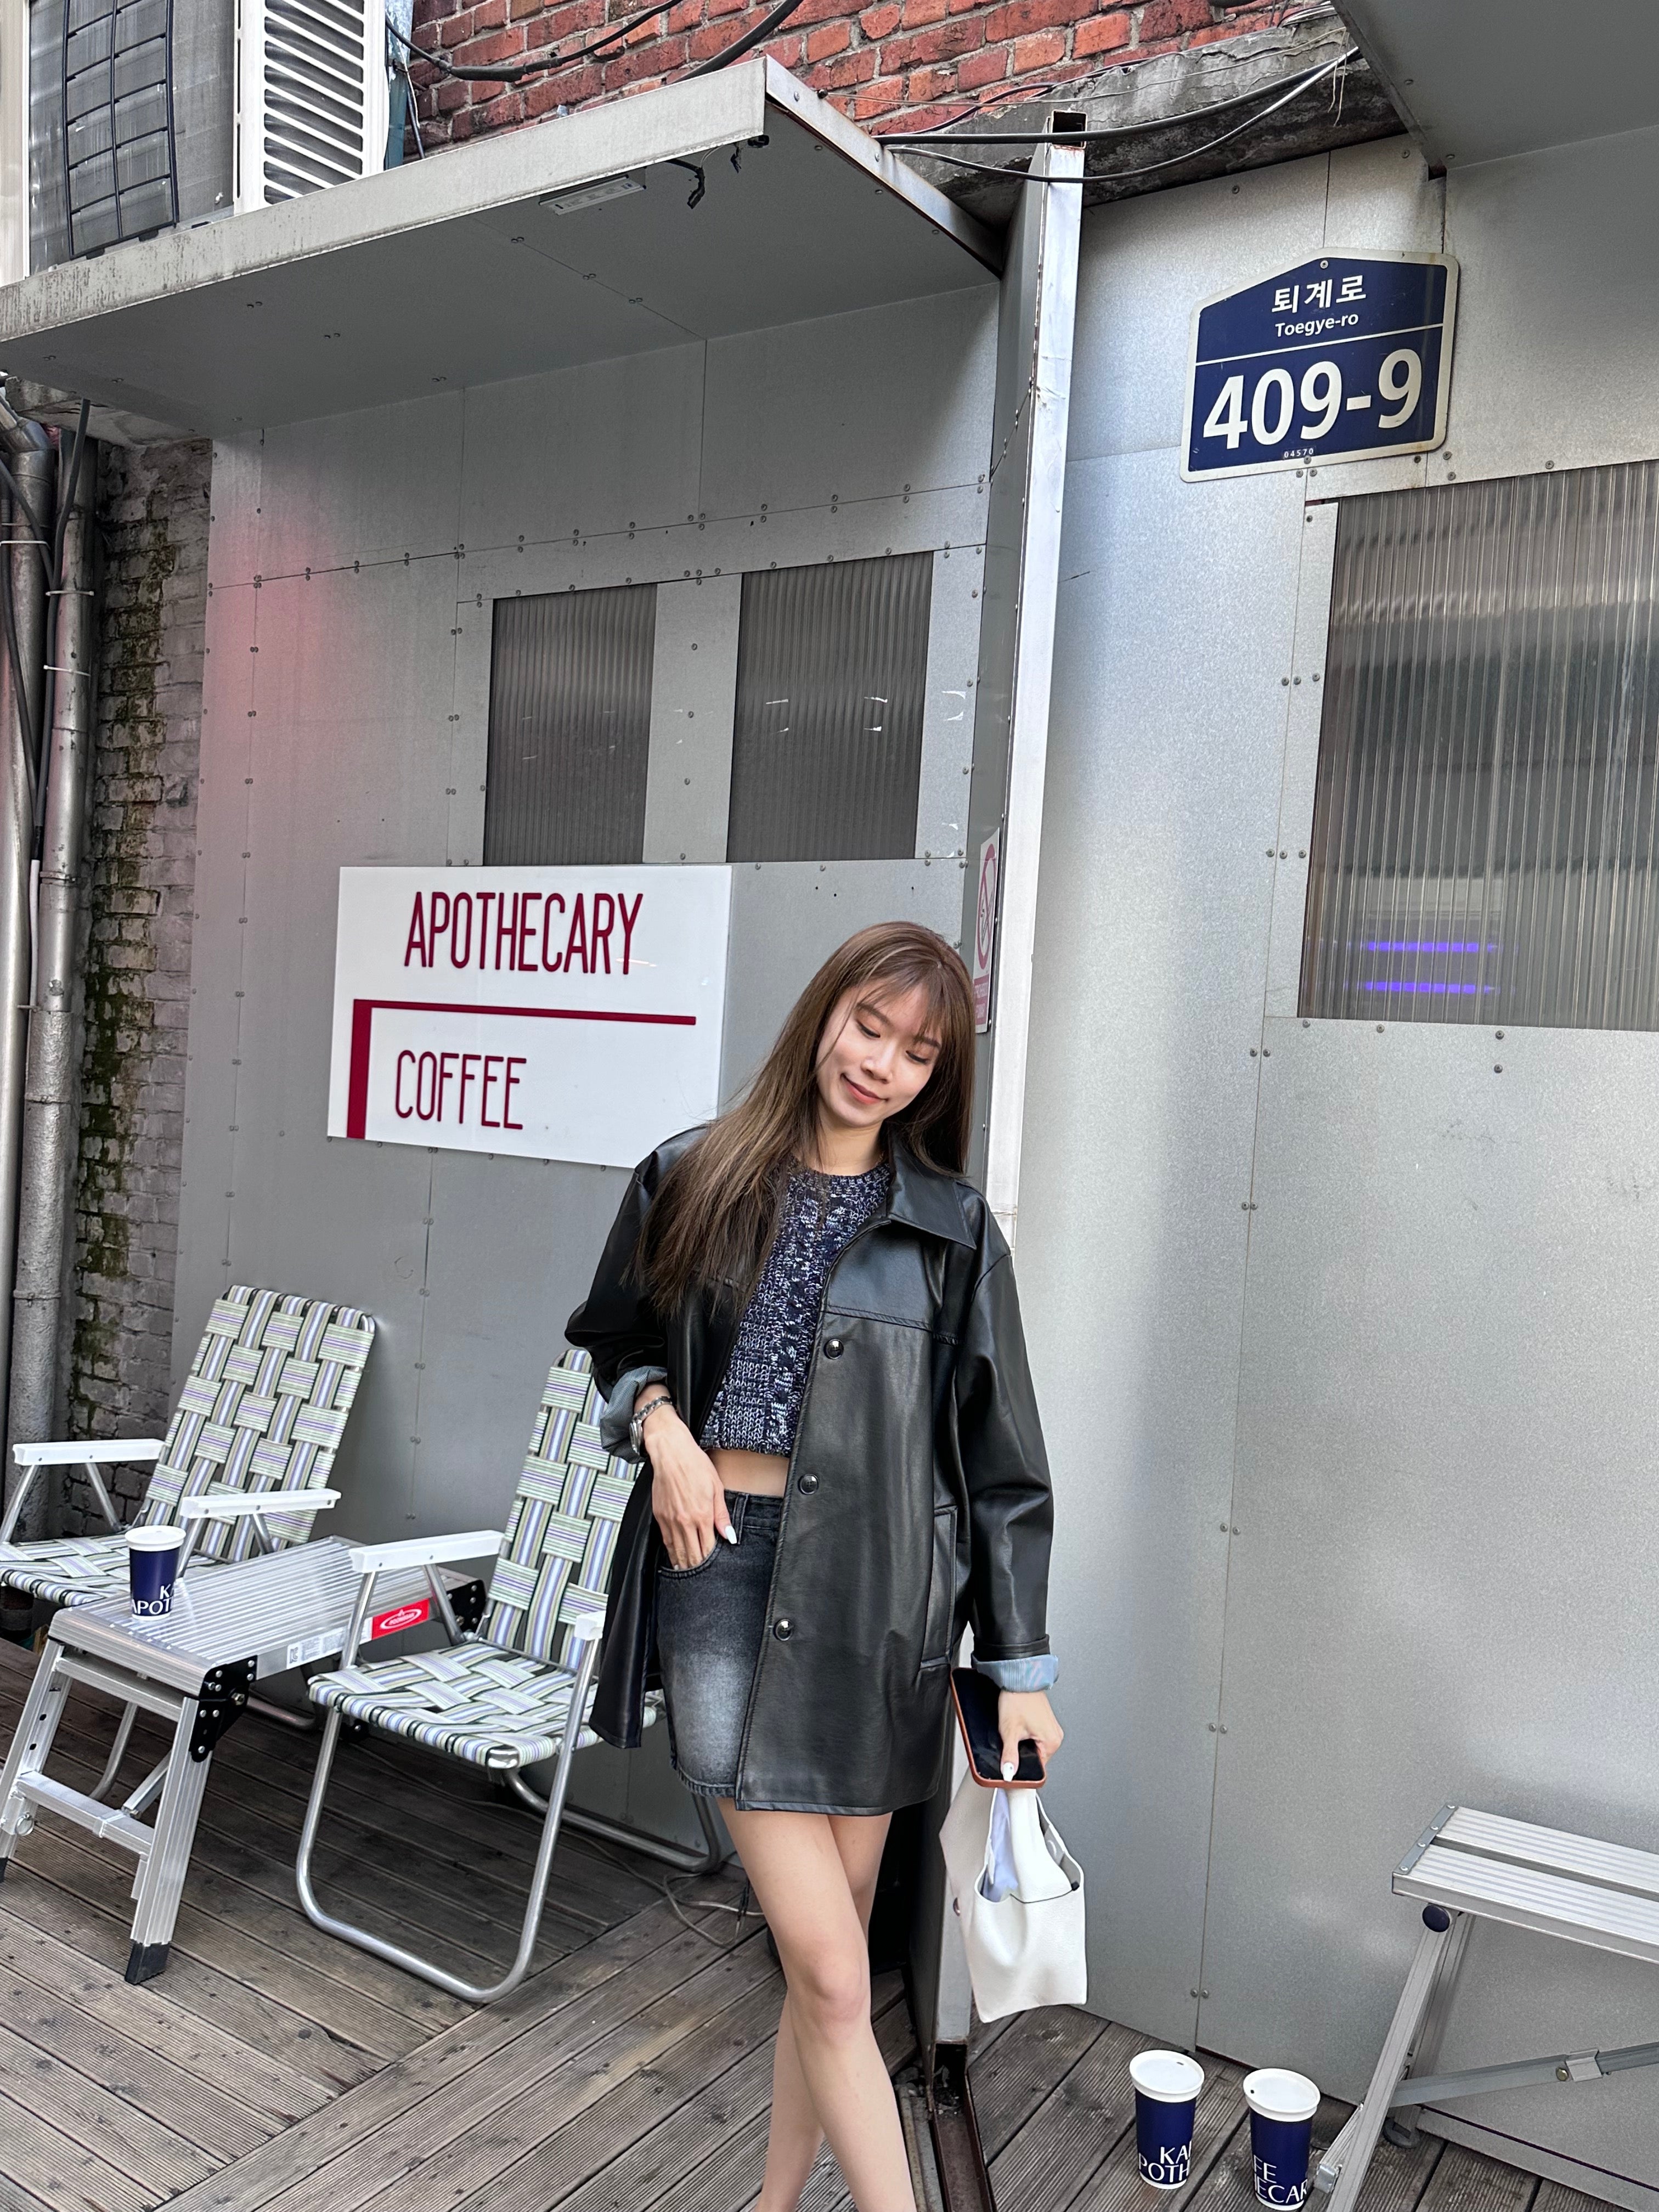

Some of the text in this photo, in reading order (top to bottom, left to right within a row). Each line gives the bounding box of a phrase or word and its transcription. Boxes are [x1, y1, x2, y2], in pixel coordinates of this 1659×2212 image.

[1271, 275, 1367, 313] 퇴계로
[1275, 314, 1359, 337] Toegye-ro
[1203, 348, 1423, 449] 409-9
[1284, 448, 1313, 458] 04570
[404, 891, 644, 975] APOTHECARY
[396, 1050, 527, 1130] COFFEE
